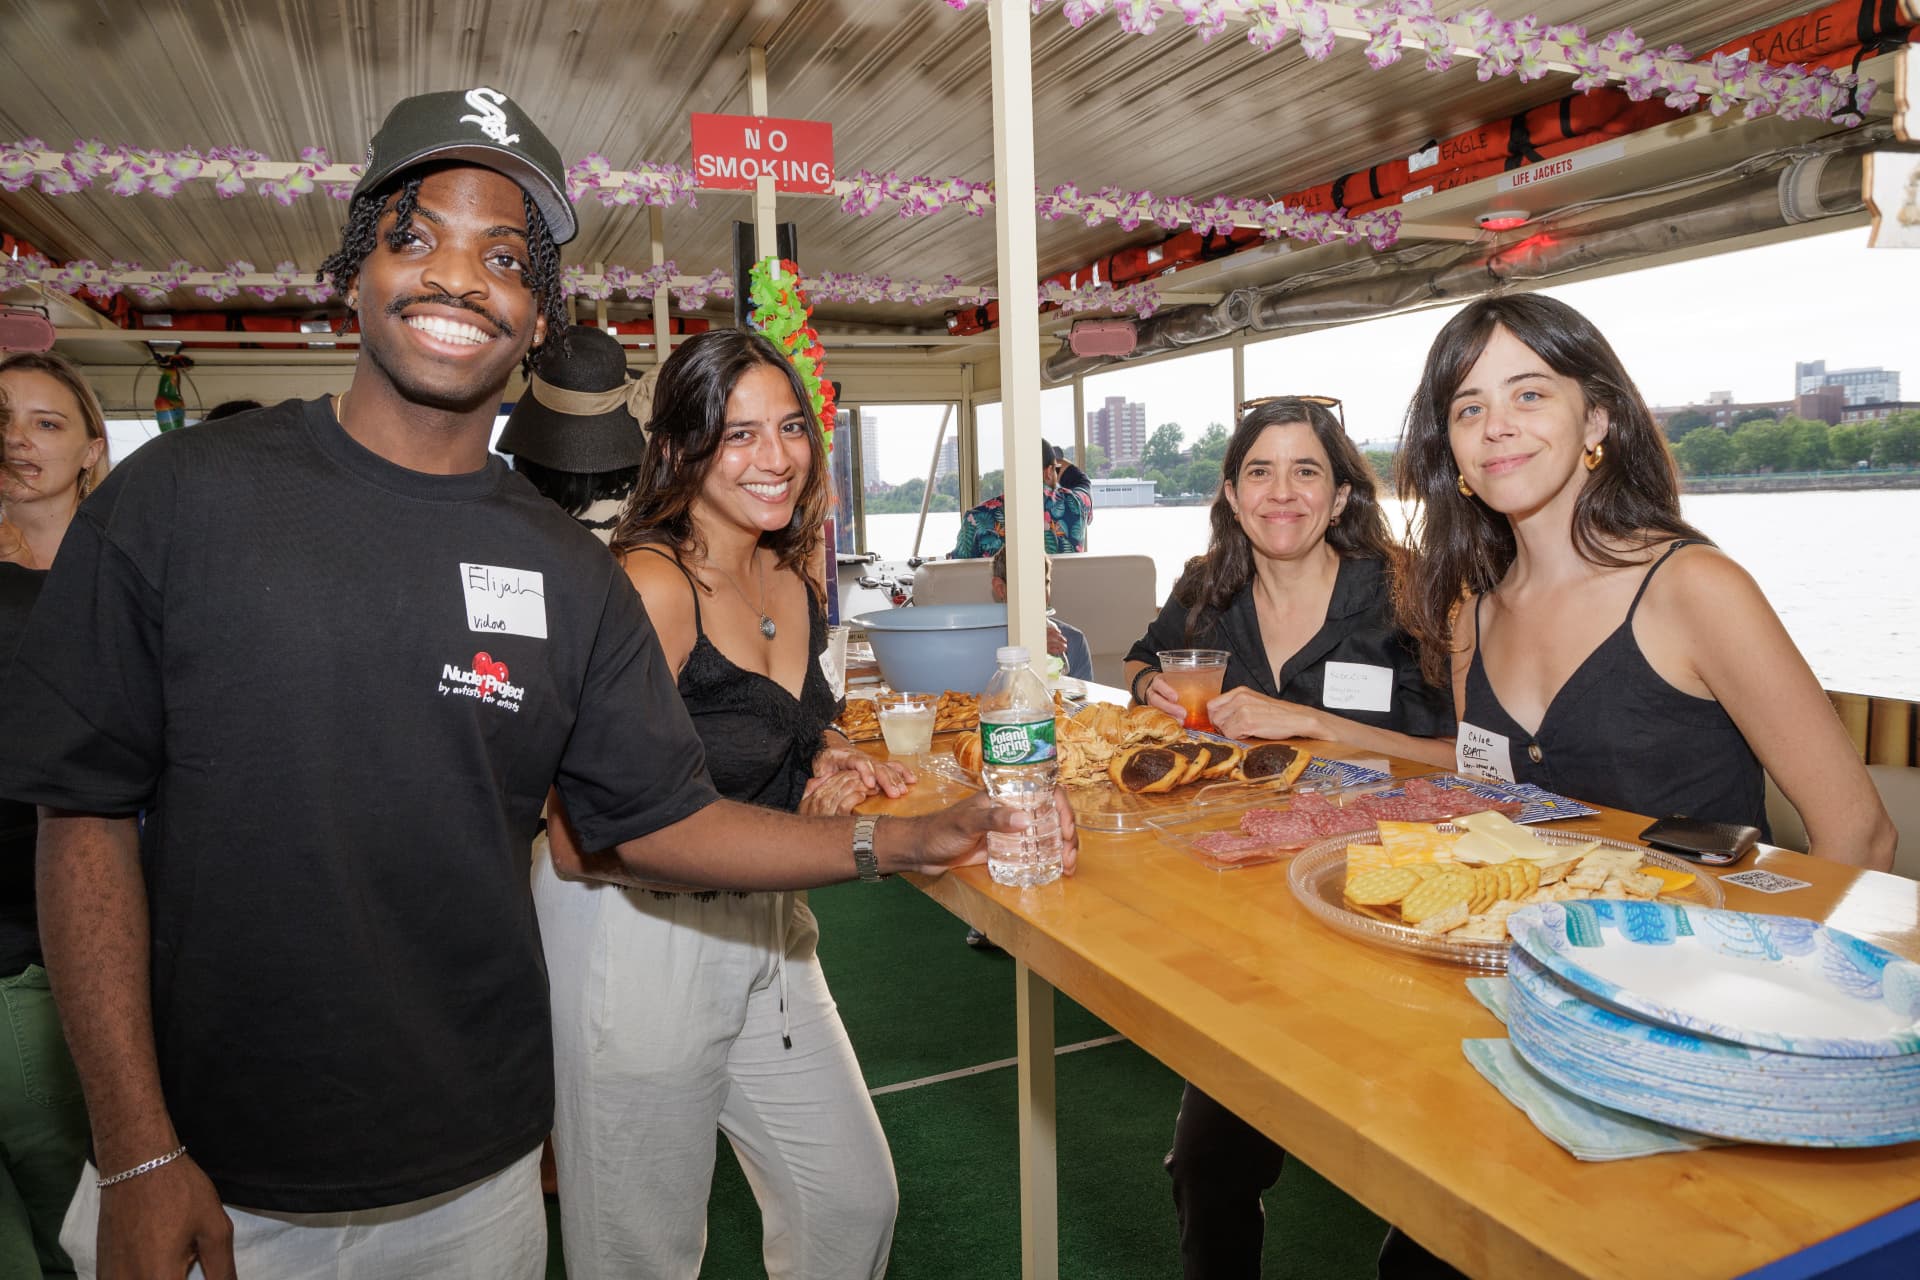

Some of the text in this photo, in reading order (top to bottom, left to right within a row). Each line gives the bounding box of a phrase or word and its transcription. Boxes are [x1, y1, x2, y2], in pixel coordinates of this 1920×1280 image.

[1751, 15, 1832, 60] EAGLE
[744, 127, 788, 153] NO
[1441, 132, 1488, 161] EAGLE
[698, 153, 830, 185] SMOKING
[1512, 158, 1573, 187] LIFE JACKETS
[468, 566, 545, 599] Elijah
[438, 681, 520, 712] by artists for artists
[989, 726, 1028, 746] Poland
[991, 739, 1030, 759] Spring
[1468, 731, 1494, 747] Chloe
